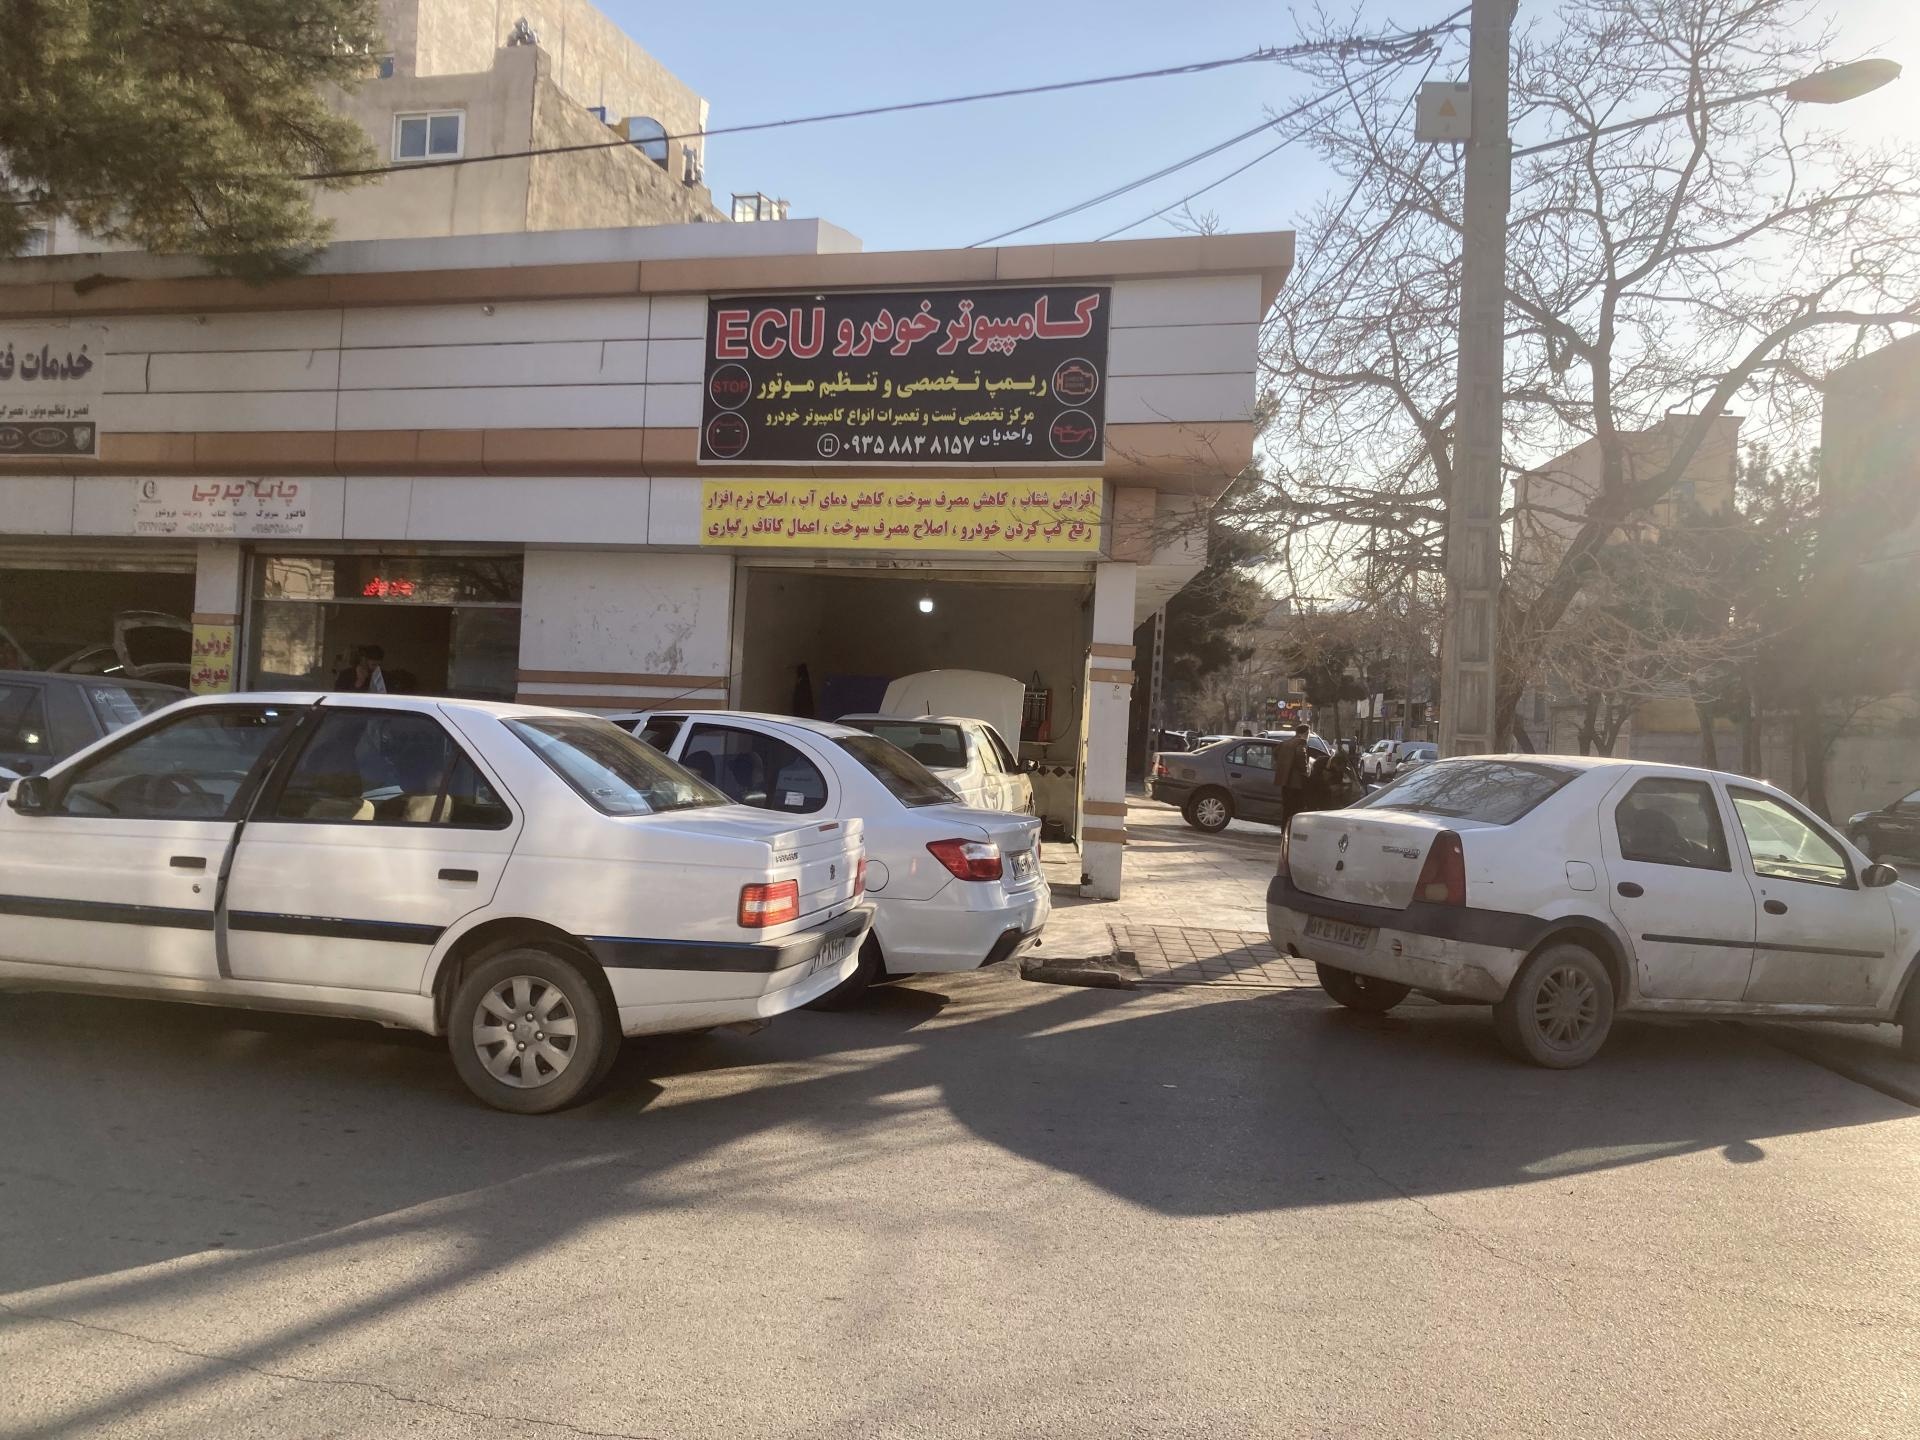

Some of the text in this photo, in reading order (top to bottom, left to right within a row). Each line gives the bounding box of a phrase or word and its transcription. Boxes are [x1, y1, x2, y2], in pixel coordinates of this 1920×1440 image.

[715, 294, 1100, 360] کامپیوتر خودرو ECU
[21, 343, 94, 381] خدمات
[713, 380, 749, 394] STOP
[756, 372, 815, 399] موتور
[818, 370, 878, 398] تنظیم
[882, 379, 893, 398] و
[896, 369, 981, 398] تخصصی
[985, 374, 1047, 399] ریمپ
[764, 406, 1035, 426] مرکز تخصصی تست و تعمیرات انواع کامپیوتر خودرو
[843, 434, 975, 455] ۰۹۳۵ ۸۸۳ ۸۱۵۷
[707, 490, 733, 510] افزار
[735, 491, 754, 510] نرم
[757, 490, 788, 509] اصلاح
[798, 489, 817, 510] آب
[819, 494, 847, 510] دمای
[850, 491, 884, 511] کاهش
[895, 491, 931, 511] سوخت
[935, 490, 969, 511] مصرف
[973, 491, 1009, 510] کاهش
[1019, 491, 1049, 511] شتاب
[1052, 490, 1096, 510] افزایش
[708, 518, 748, 538] رگباری
[752, 518, 784, 534] کاتاف
[787, 518, 820, 537] اعمال
[831, 519, 870, 540] سوخت
[873, 518, 910, 540] مصرف
[913, 519, 949, 540] اصلاح
[960, 521, 1001, 542] خودرو
[1004, 520, 1040, 541] کردن
[1068, 519, 1092, 542] رفع
